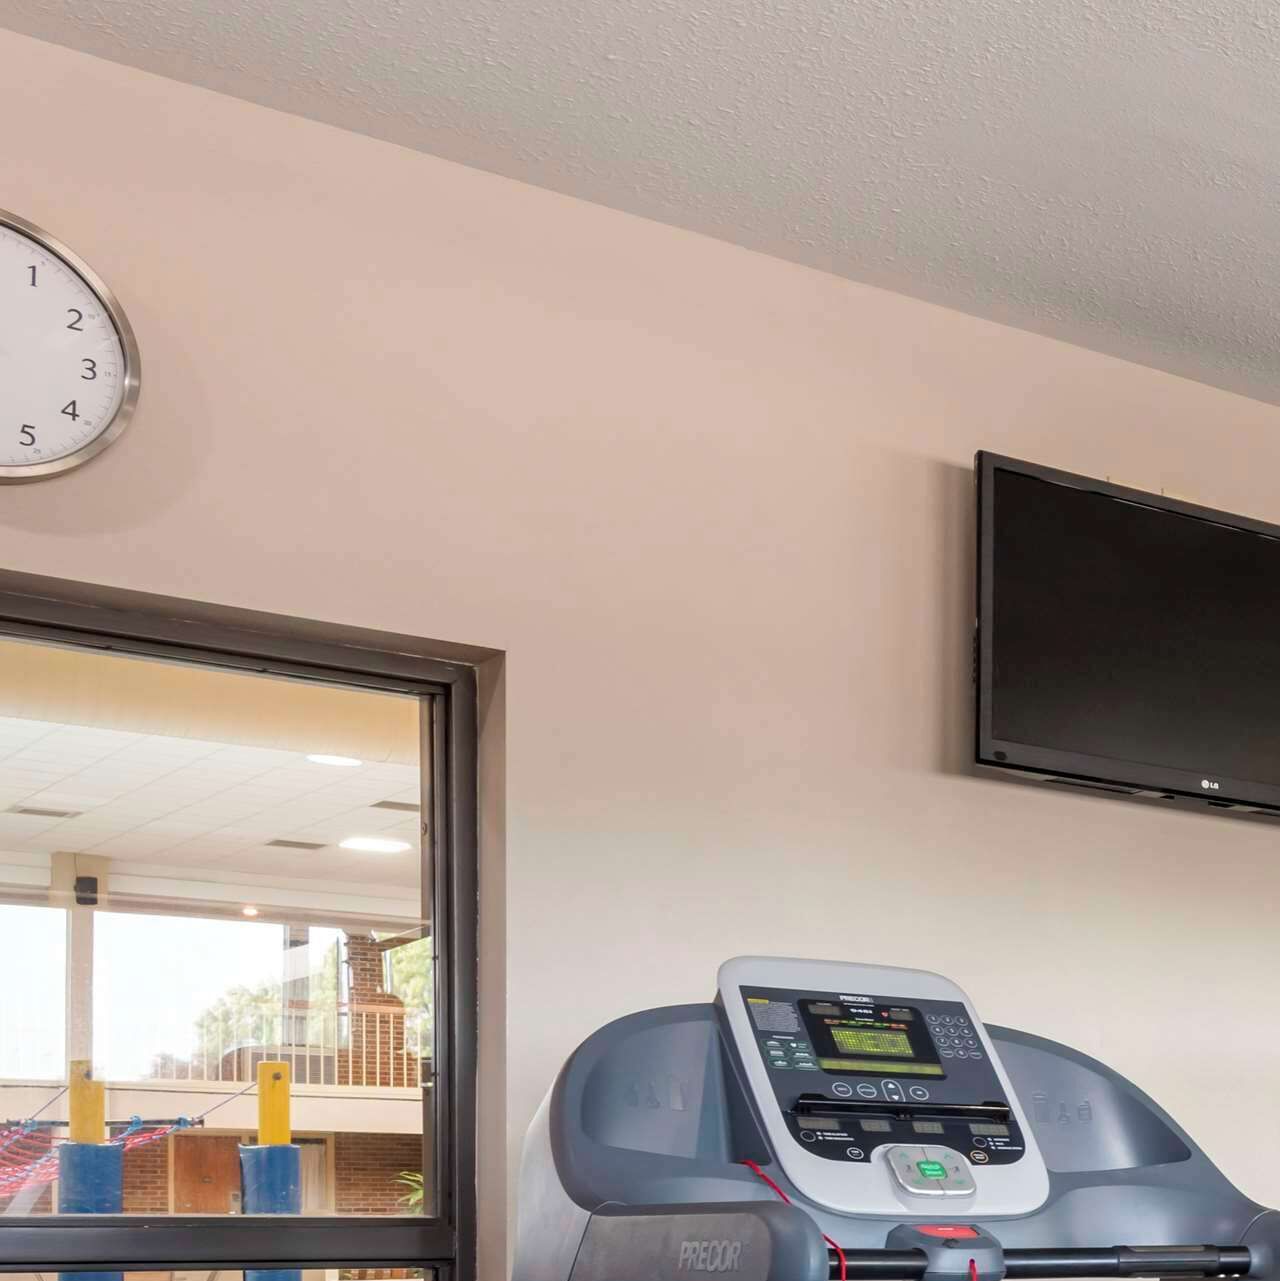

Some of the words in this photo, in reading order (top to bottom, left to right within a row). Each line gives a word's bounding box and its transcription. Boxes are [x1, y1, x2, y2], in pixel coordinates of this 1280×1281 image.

[27, 265, 38, 287] 1
[66, 308, 83, 331] 2
[81, 358, 97, 380] 3
[60, 400, 80, 421] 4
[19, 424, 36, 446] 5
[679, 1240, 742, 1273] PRECOR
